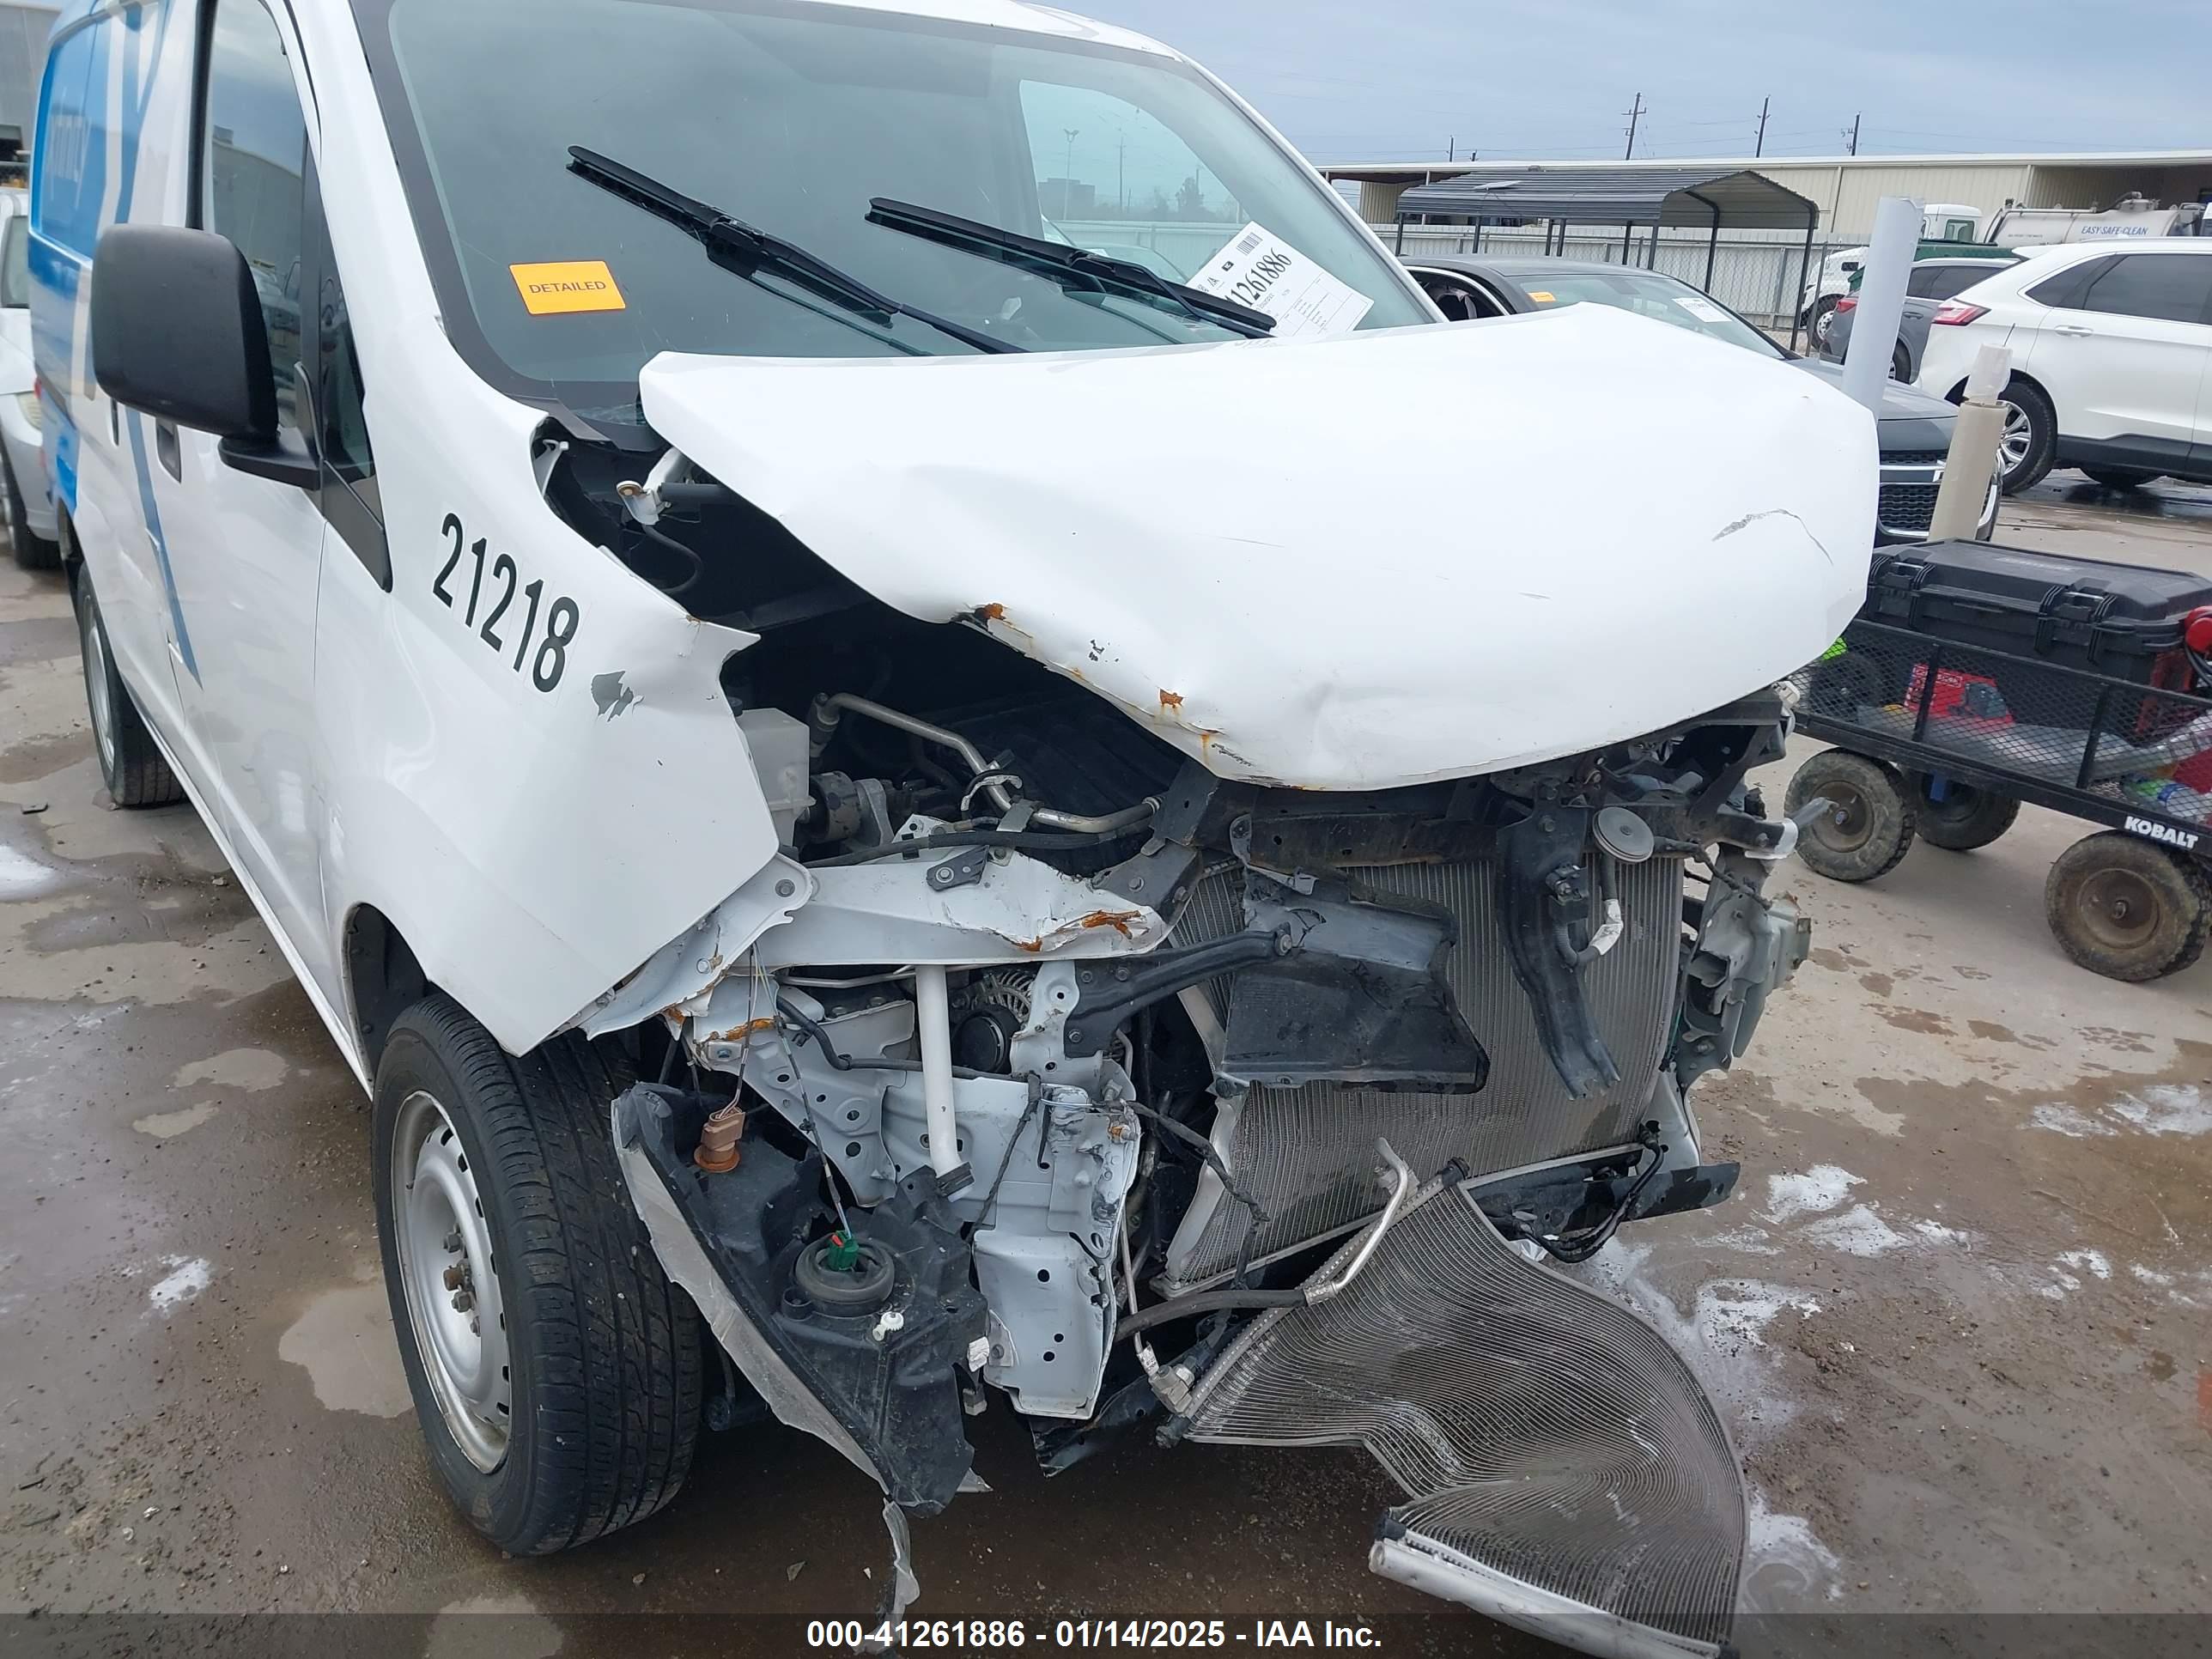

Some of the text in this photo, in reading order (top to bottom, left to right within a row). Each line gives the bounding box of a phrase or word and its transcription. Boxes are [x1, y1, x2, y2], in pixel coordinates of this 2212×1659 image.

[528, 281, 606, 294] DETAILED
[432, 513, 580, 694] 21218
[2124, 816, 2199, 849] KOBALT
